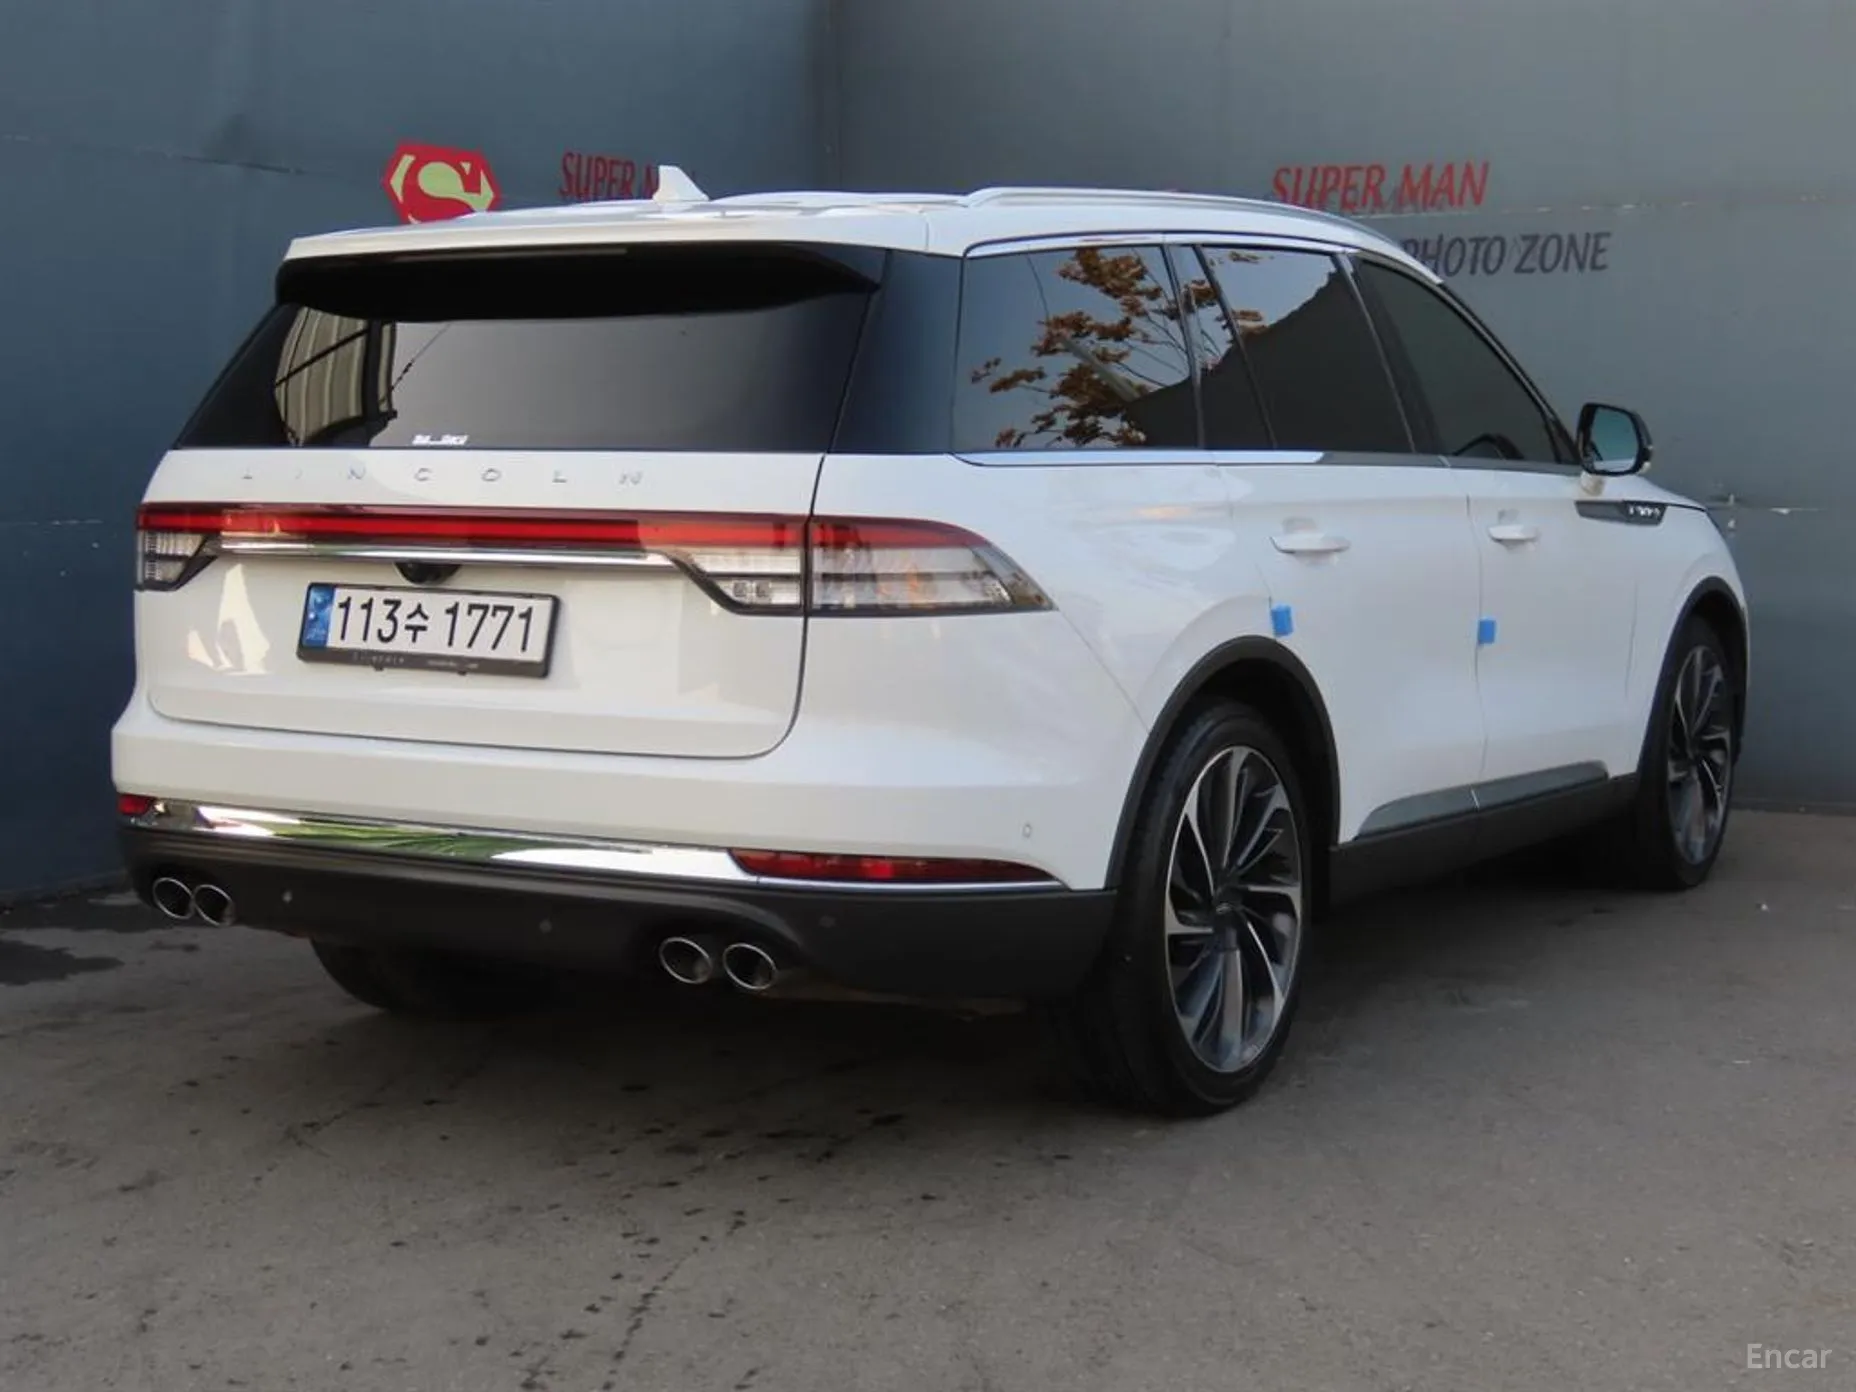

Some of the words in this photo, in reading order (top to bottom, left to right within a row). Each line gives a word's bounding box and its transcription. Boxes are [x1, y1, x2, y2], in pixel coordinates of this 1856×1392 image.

[559, 152, 636, 200] SUPER
[1272, 163, 1385, 214] SUPER
[1399, 160, 1489, 209] MAN
[1513, 231, 1612, 274] ZONE
[338, 596, 429, 643] 113수
[445, 602, 533, 653] 1771
